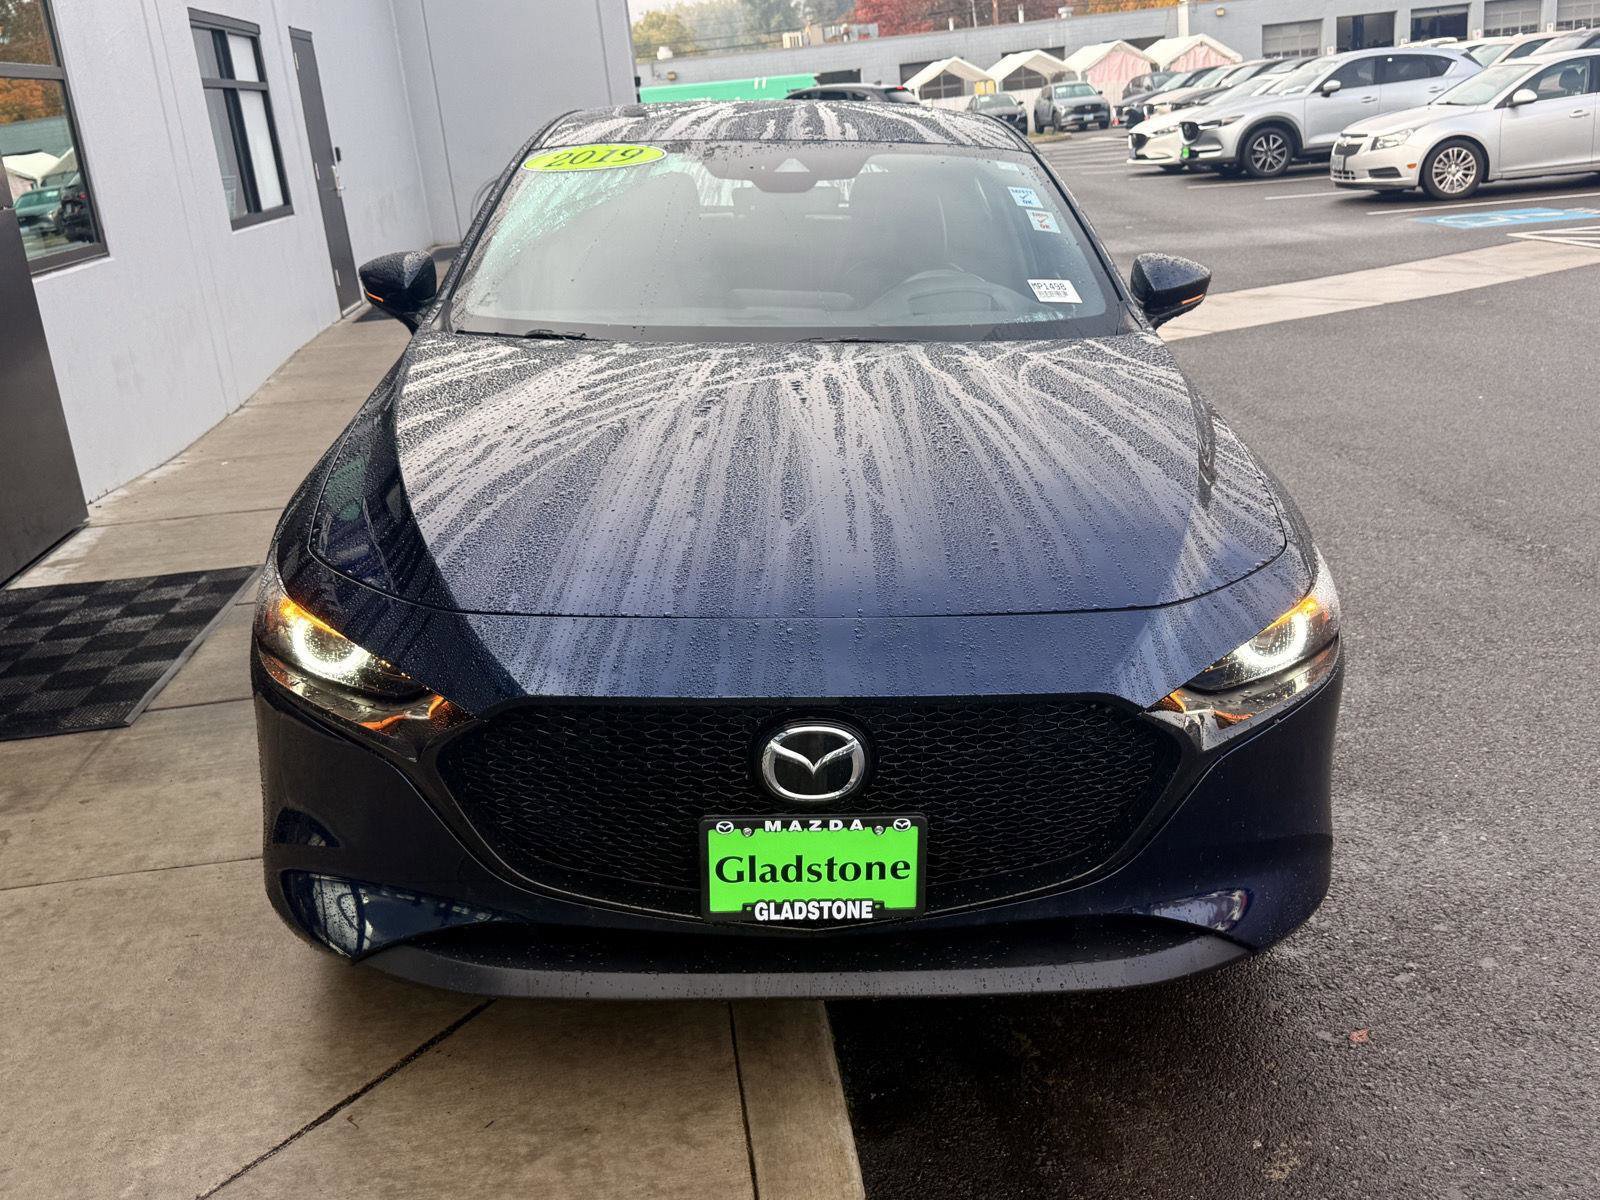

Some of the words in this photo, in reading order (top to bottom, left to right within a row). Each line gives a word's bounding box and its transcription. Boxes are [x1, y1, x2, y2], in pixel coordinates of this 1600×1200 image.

[544, 148, 645, 167] 2019
[764, 819, 864, 832] MAZDA
[715, 855, 911, 884] Gladstone
[754, 900, 873, 921] GLADSTONE
